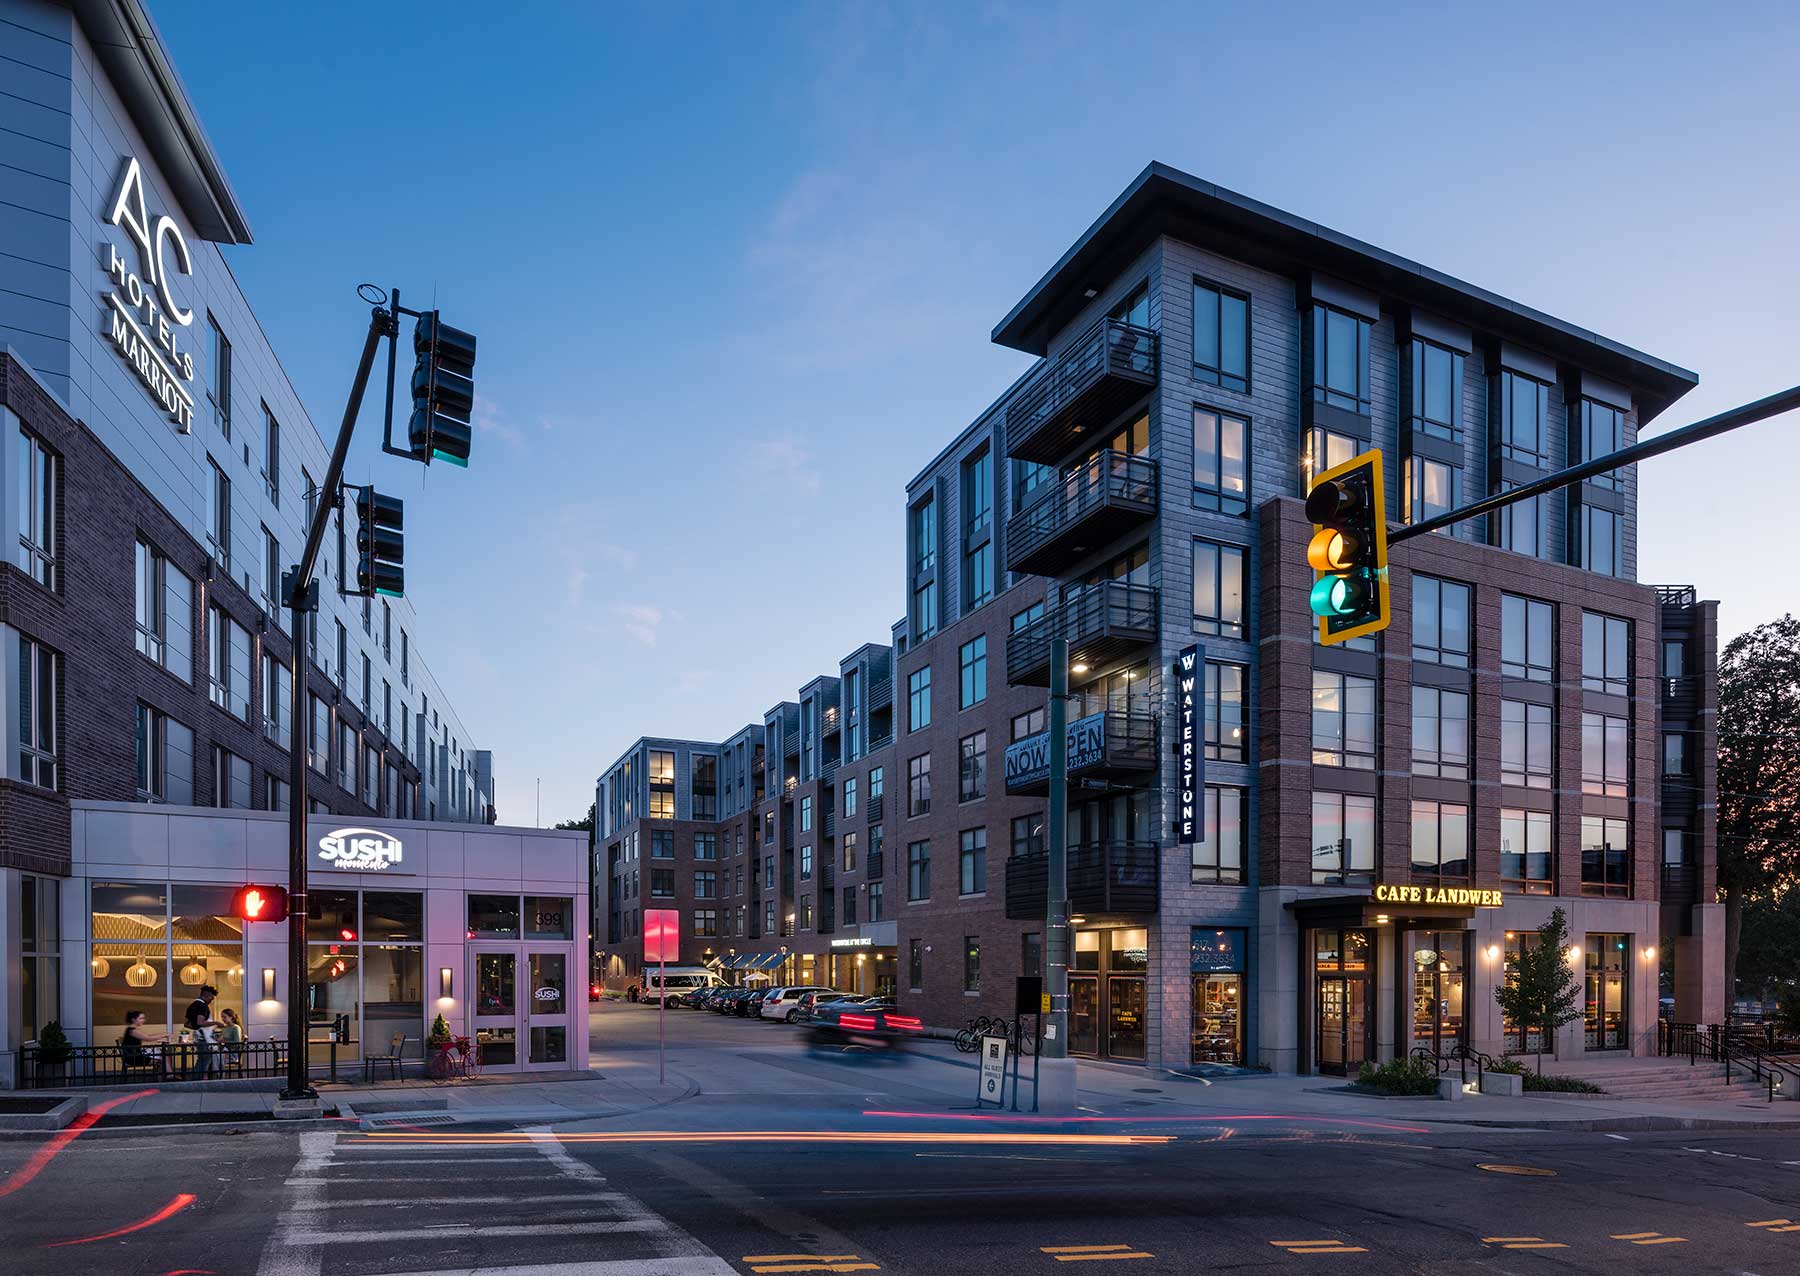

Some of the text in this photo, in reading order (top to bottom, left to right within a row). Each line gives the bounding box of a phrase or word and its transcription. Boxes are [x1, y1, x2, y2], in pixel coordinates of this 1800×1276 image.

[111, 156, 194, 326] AC
[110, 244, 193, 381] HOTELS
[111, 310, 193, 435] MARRIOTT
[1007, 744, 1047, 777] NOW
[1067, 725, 1103, 758] PEN
[1182, 677, 1195, 835] WATERSTONE
[318, 837, 402, 862] SUSHI
[535, 912, 561, 926] 399
[1376, 885, 1503, 905] CAFE LANDWER
[534, 990, 560, 999] SUSHI
